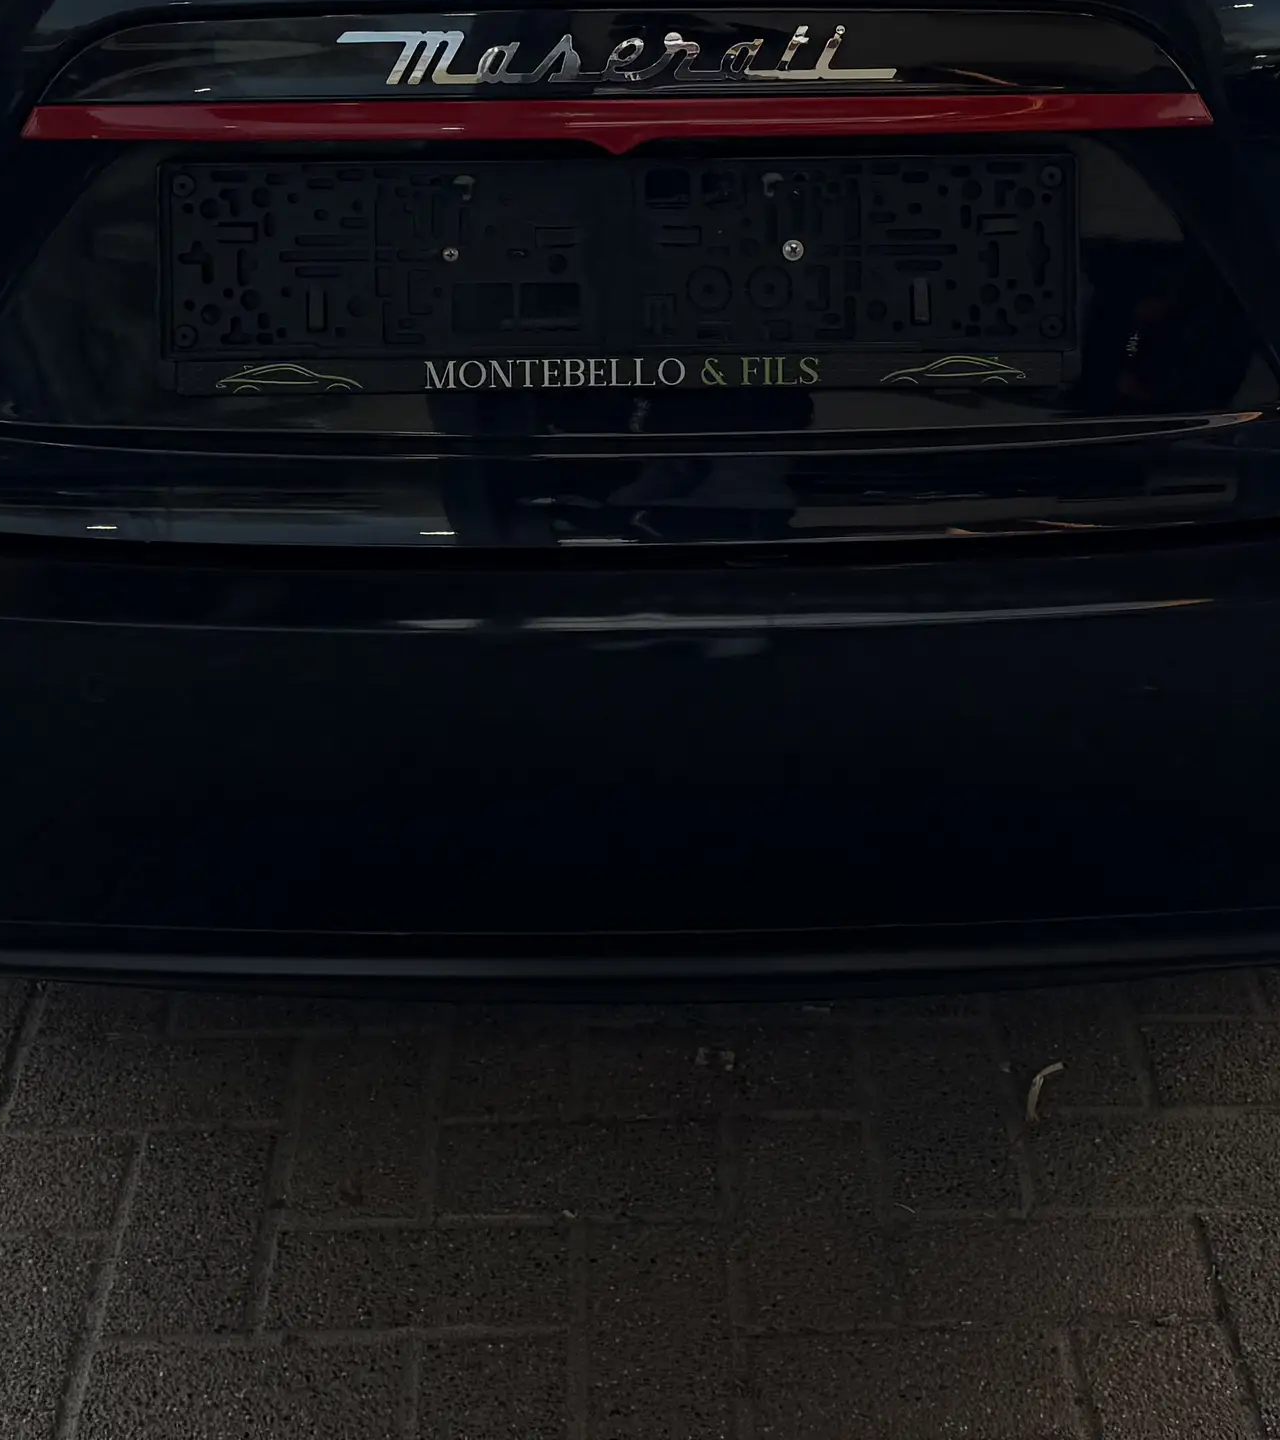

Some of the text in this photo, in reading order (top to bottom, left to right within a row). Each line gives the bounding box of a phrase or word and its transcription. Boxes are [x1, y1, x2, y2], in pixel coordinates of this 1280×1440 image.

[338, 25, 898, 85] Maserati
[424, 356, 820, 389] MONTEBELLO & FILS
